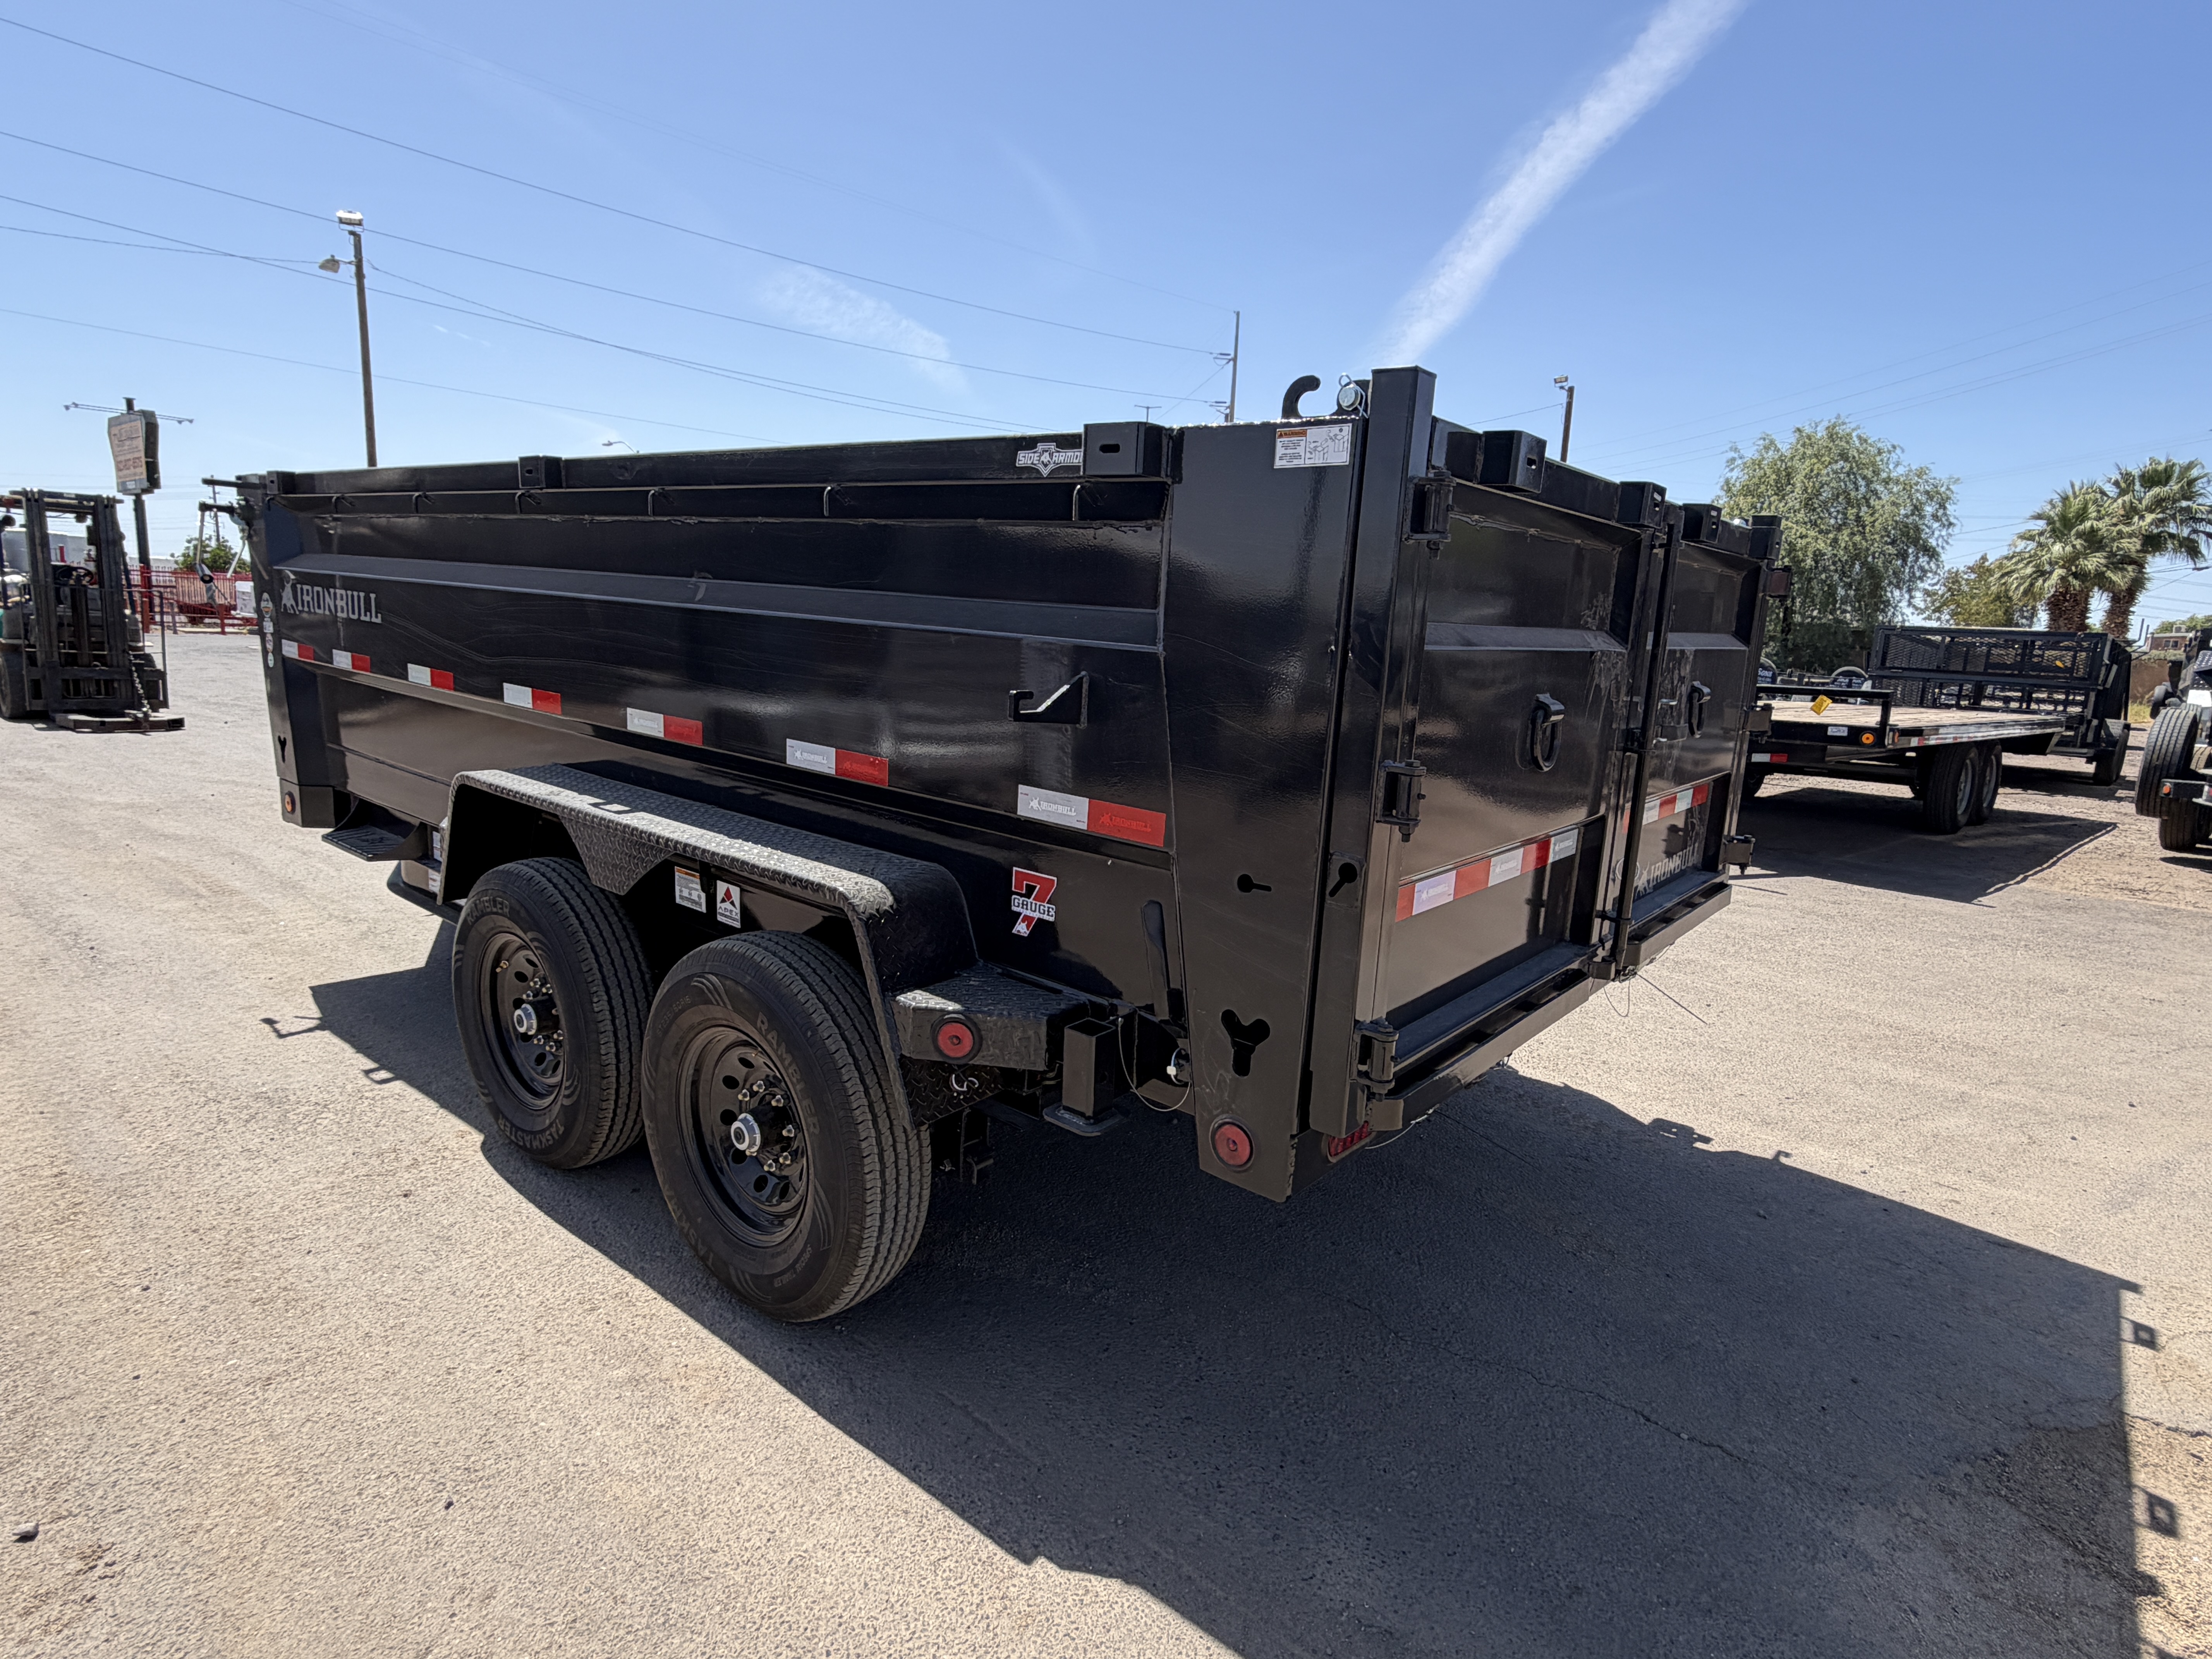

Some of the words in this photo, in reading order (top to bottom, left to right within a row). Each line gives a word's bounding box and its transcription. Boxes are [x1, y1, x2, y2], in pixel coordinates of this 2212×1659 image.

[1018, 453, 1040, 464] SIDE
[296, 584, 382, 623] IRONBULL
[1040, 801, 1076, 816] IRONBULL
[465, 896, 510, 926] RAMBLER
[1012, 867, 1057, 937] 7
[1013, 897, 1054, 918] GAUGE
[757, 1012, 820, 1135] RAMBLER
[498, 1114, 565, 1149] TASKMASTER
